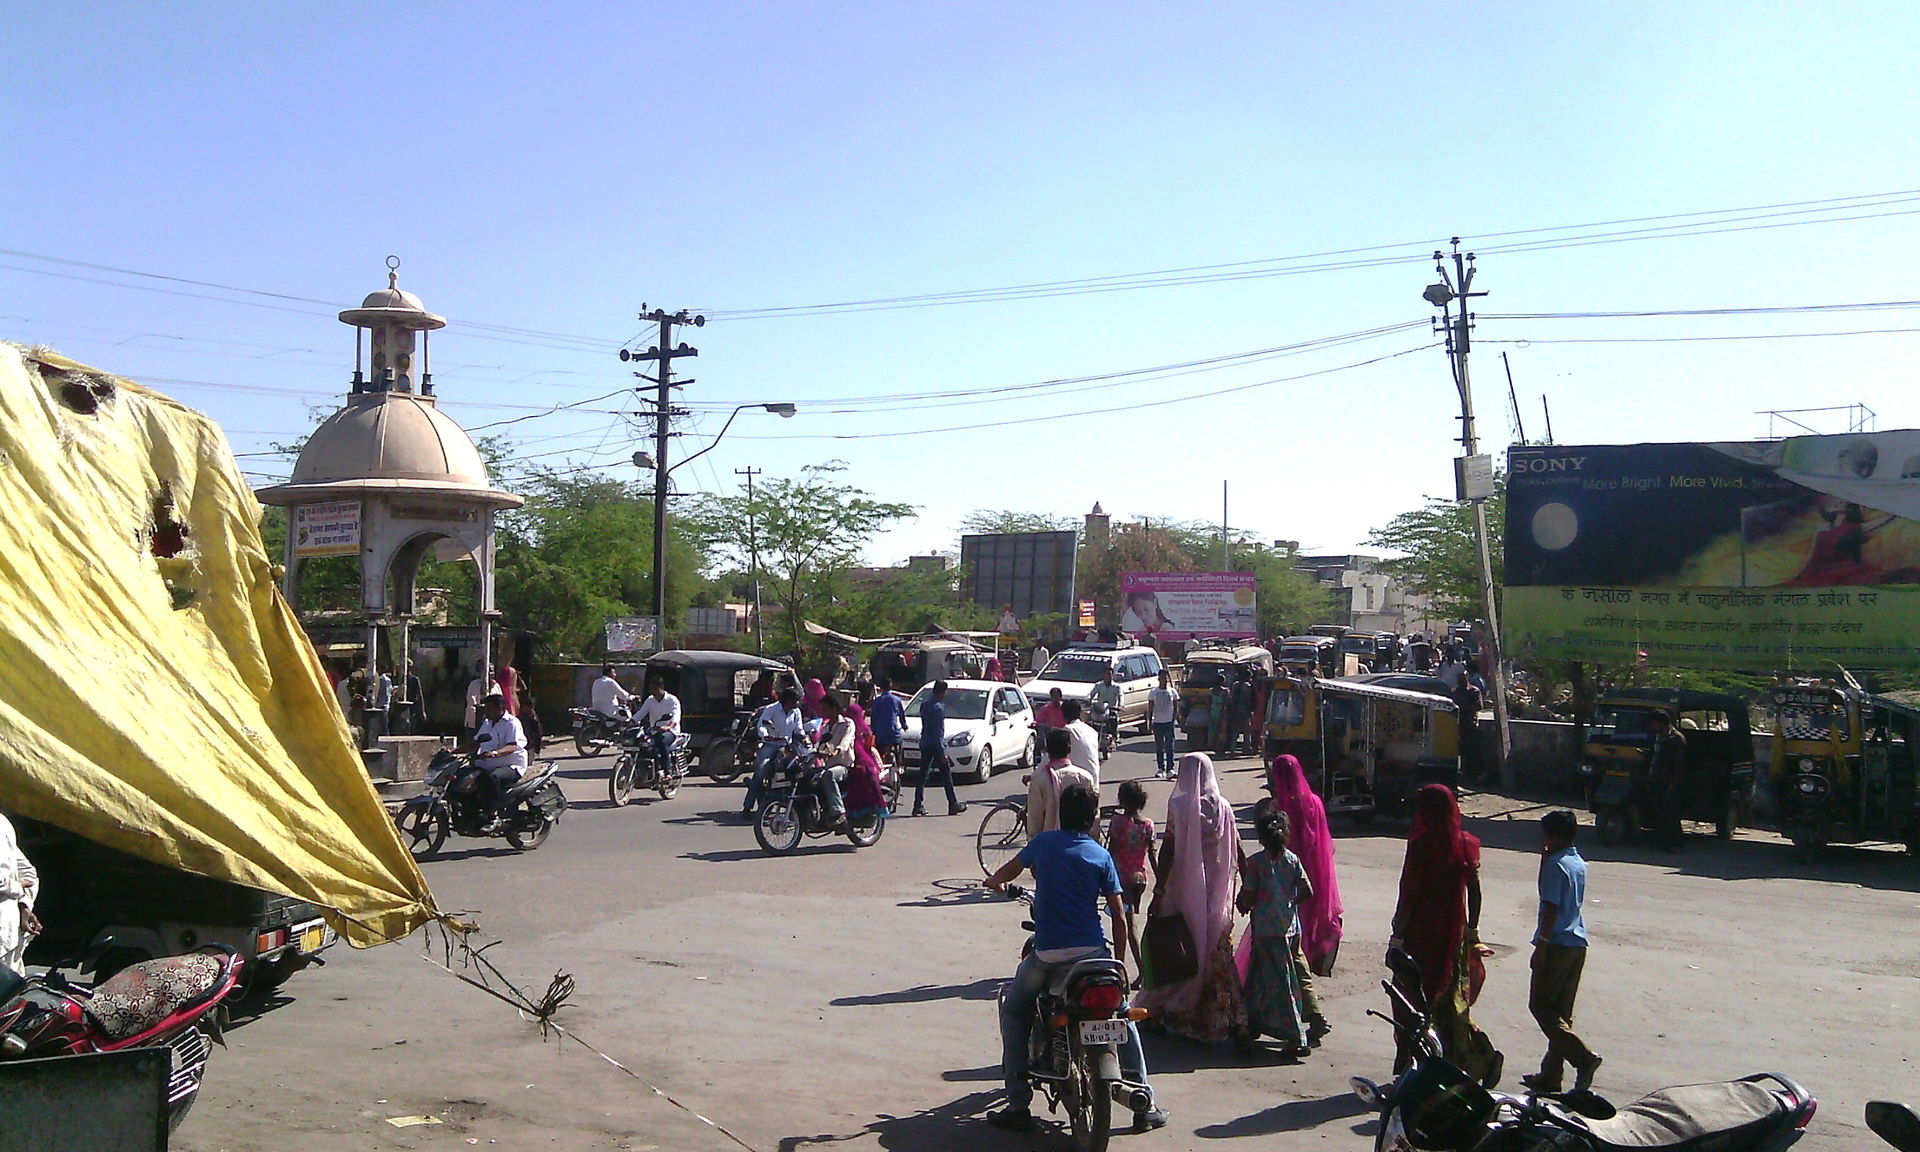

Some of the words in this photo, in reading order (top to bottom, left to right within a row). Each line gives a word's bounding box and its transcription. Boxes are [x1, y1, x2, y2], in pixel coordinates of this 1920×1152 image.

[1514, 457, 1587, 473] SONY
[1583, 477, 1618, 490] More
[1669, 475, 1707, 488] More
[1640, 592, 1672, 604] नगर
[1772, 591, 1811, 606] मंगल
[1817, 589, 1850, 606] प्रवेश
[1858, 593, 1879, 605] पर
[1058, 654, 1111, 663] TOURIST
